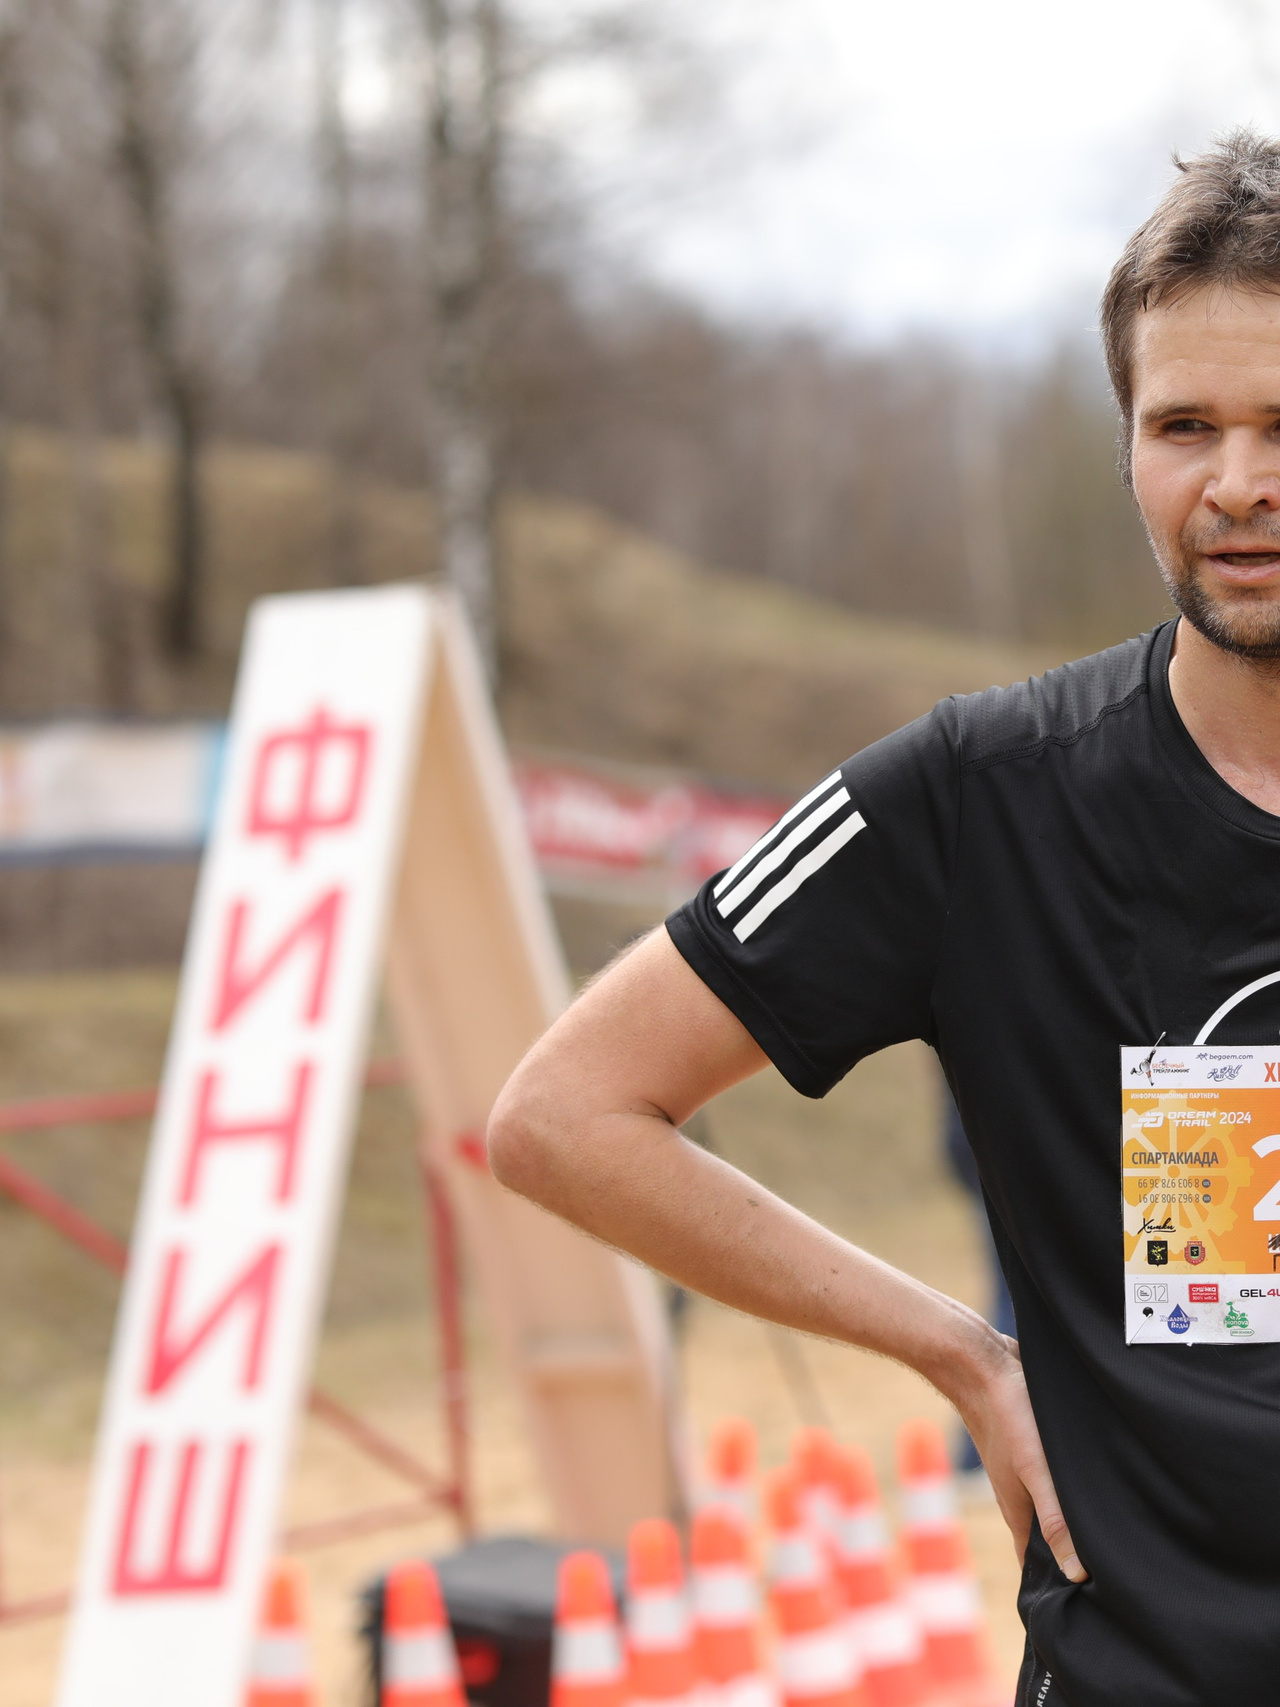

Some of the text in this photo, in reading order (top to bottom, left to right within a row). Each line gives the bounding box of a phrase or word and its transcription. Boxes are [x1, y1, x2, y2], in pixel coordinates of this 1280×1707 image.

[1130, 1092, 1188, 1100] ИНФОРМАЦИОННЫЕ
[1167, 1111, 1217, 1119] DREAM
[1219, 1111, 1252, 1125] 2024
[1174, 1119, 1212, 1127] TRAIL
[107, 698, 376, 1598] ФИНИШ
[1131, 1151, 1219, 1167] СПАРТАКИАДА
[1223, 1318, 1249, 1326] bionova
[1036, 1671, 1052, 1707] READY
